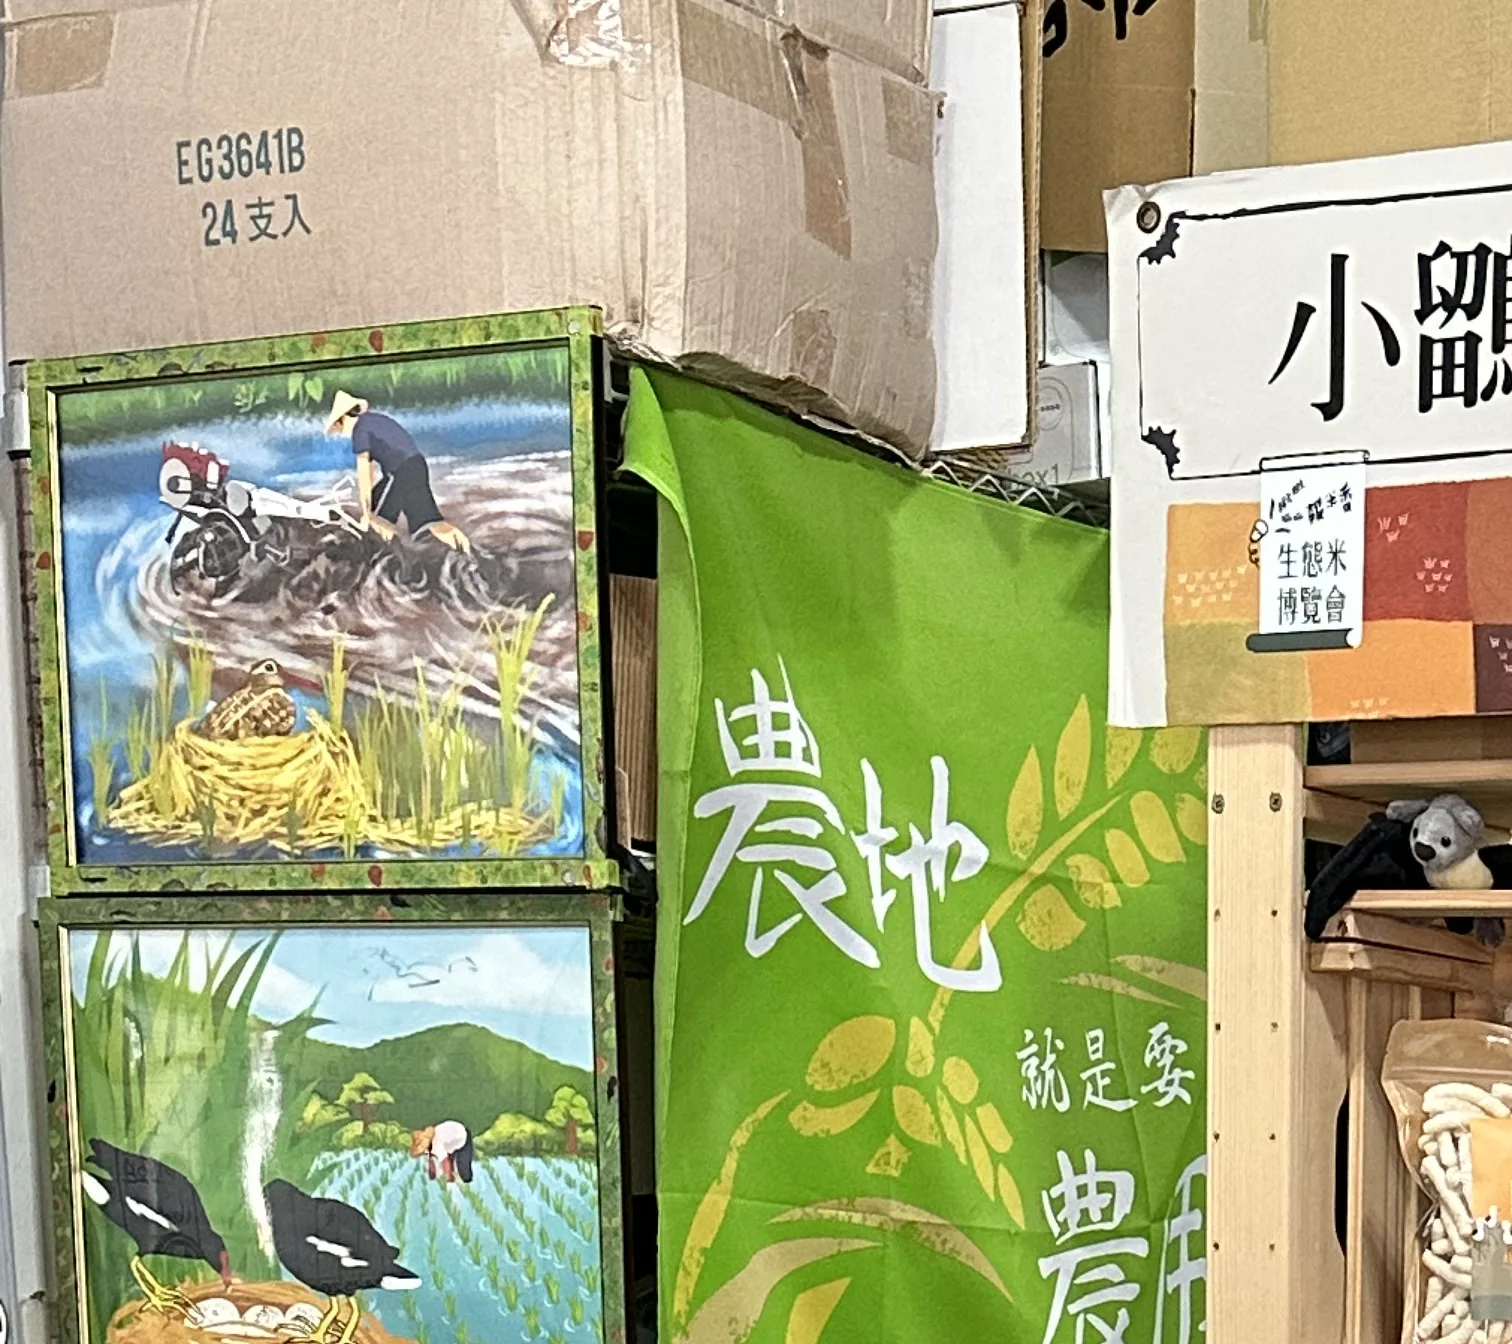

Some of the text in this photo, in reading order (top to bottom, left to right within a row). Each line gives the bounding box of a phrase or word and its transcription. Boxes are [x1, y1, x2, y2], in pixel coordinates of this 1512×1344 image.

[175, 126, 307, 187] EG3641B
[1277, 538, 1347, 579] 生態米
[1277, 585, 1346, 626] 博覽會
[683, 655, 1001, 992] 農地
[1016, 1022, 1195, 1113] 就是要
